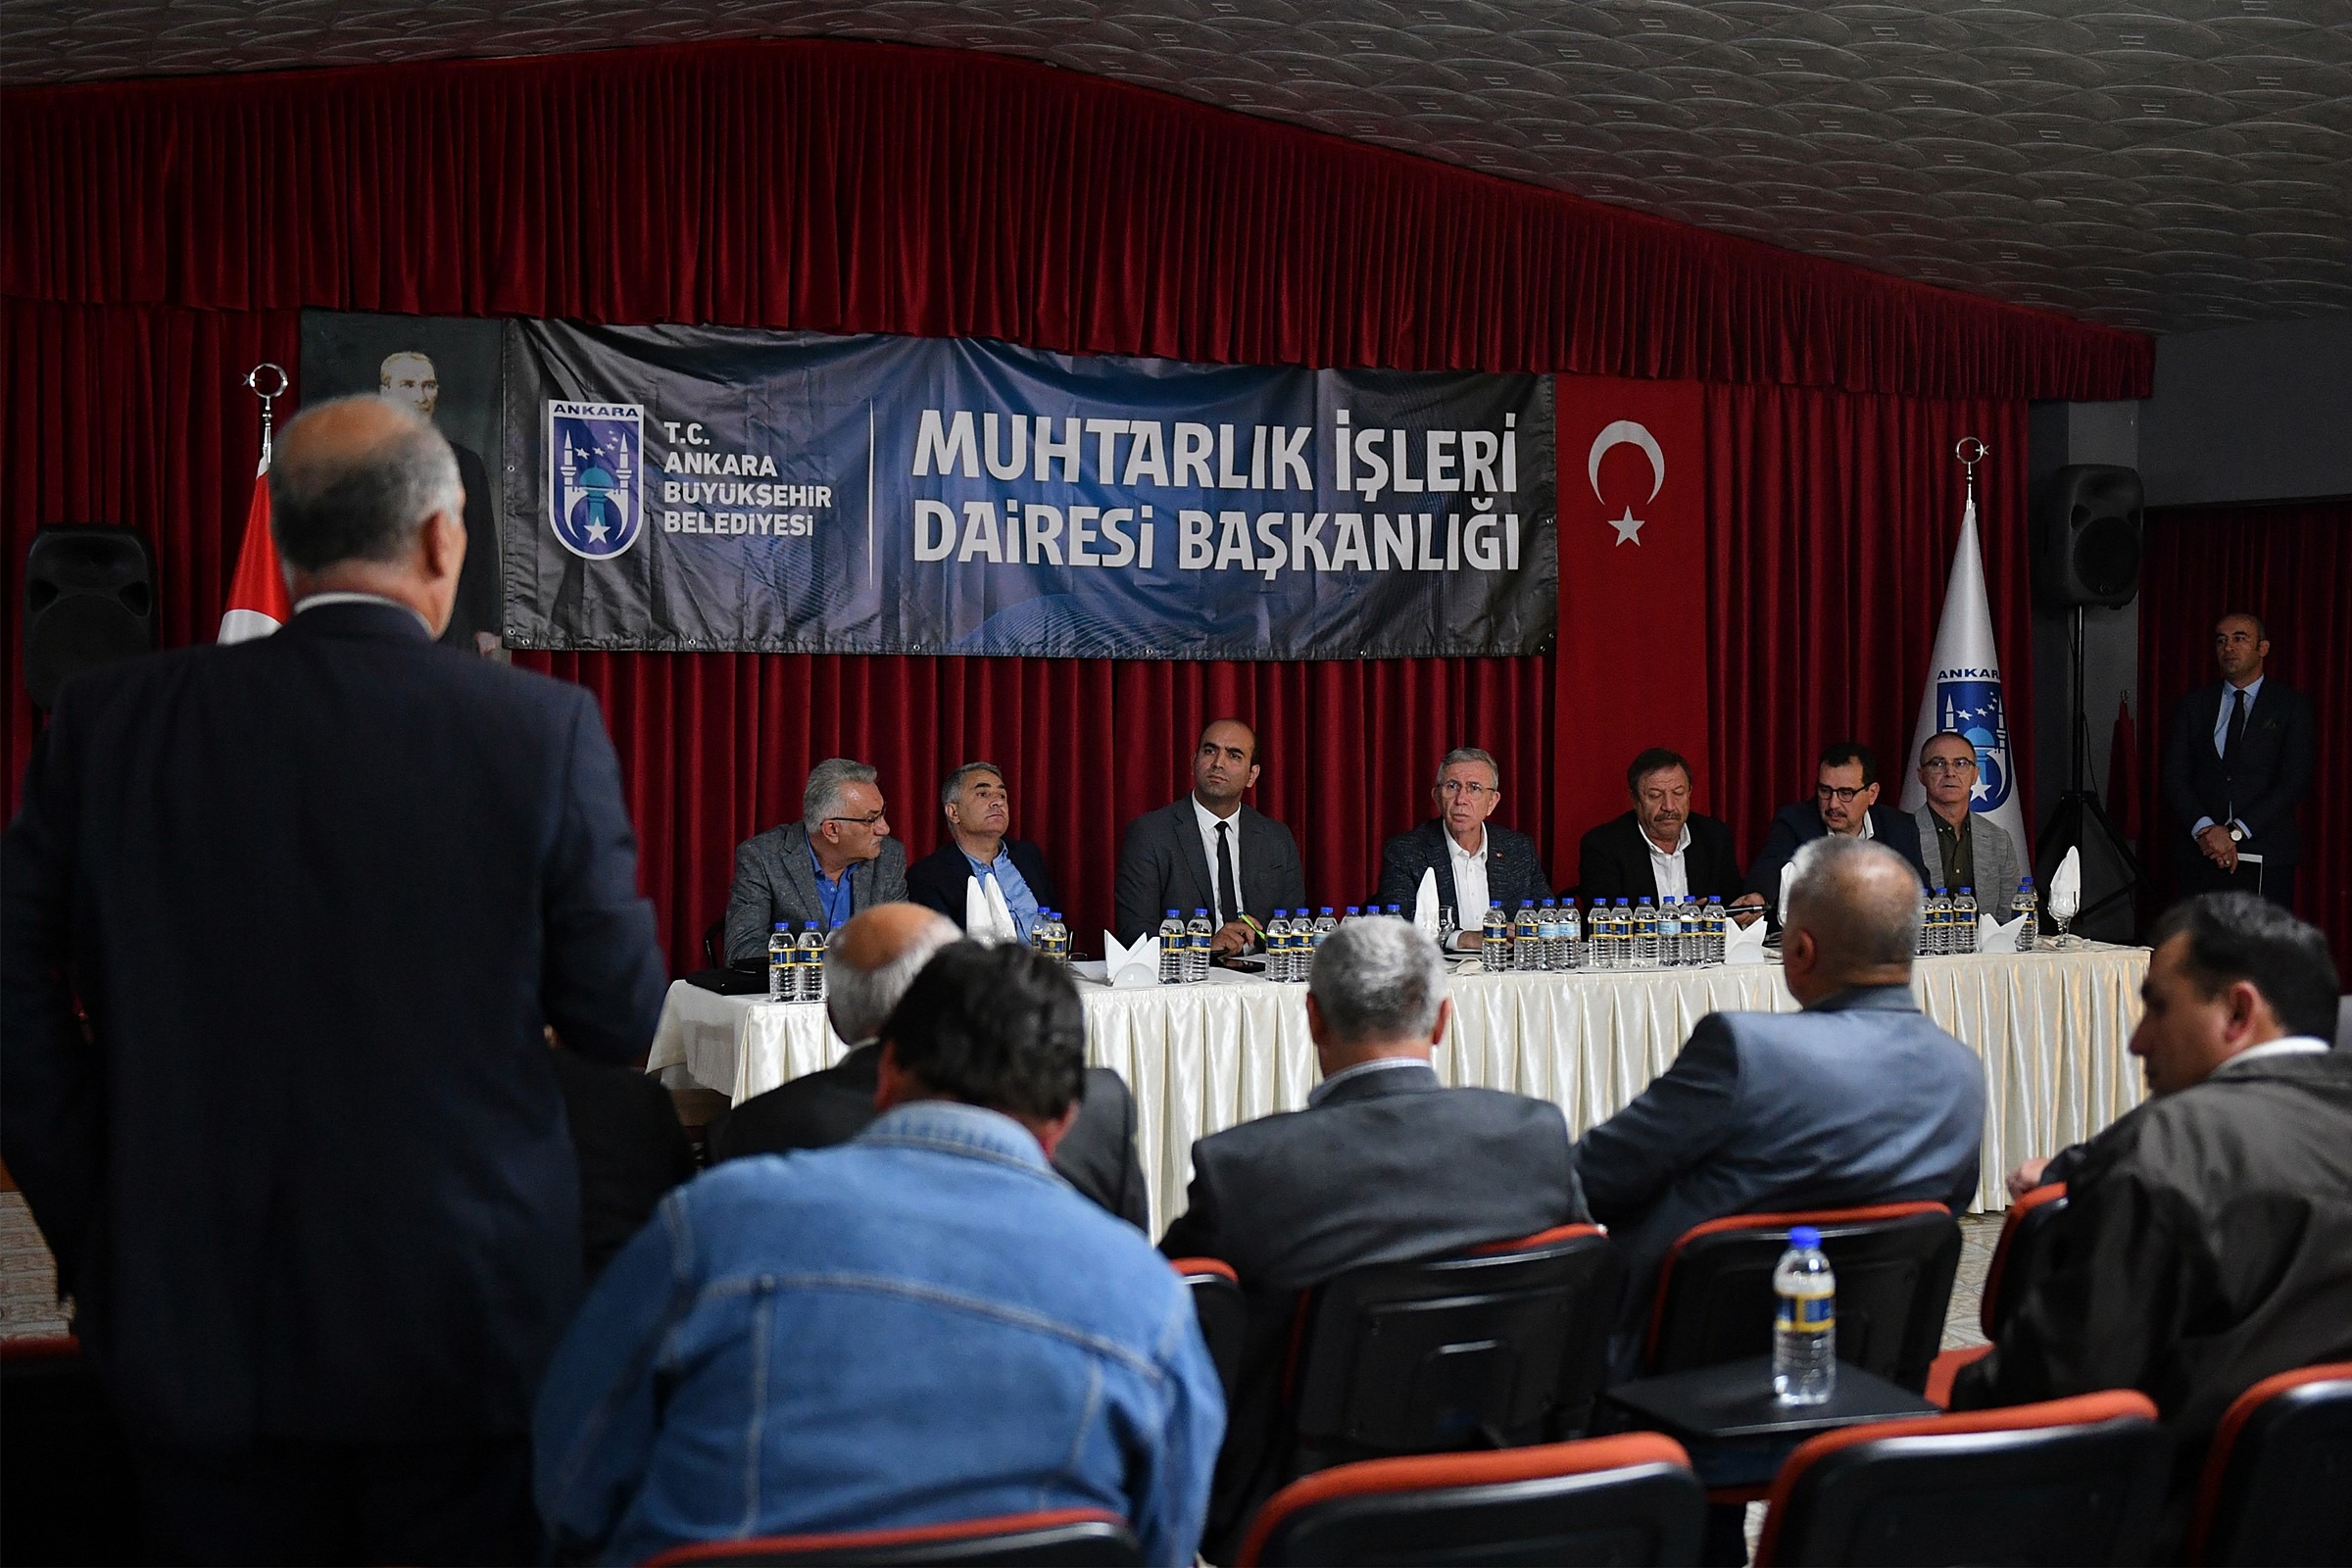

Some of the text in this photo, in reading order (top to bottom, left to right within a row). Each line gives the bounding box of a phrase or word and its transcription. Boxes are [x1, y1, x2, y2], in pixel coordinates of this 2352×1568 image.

[553, 403, 639, 417] ANKARA
[663, 421, 710, 445] T.C.
[663, 451, 778, 477] ANKARA
[911, 409, 1517, 503] MUHTARLIK İŞLERİ
[1179, 497, 1519, 580] BAŞKANLIĞI
[1936, 668, 1999, 680] ANKAR
